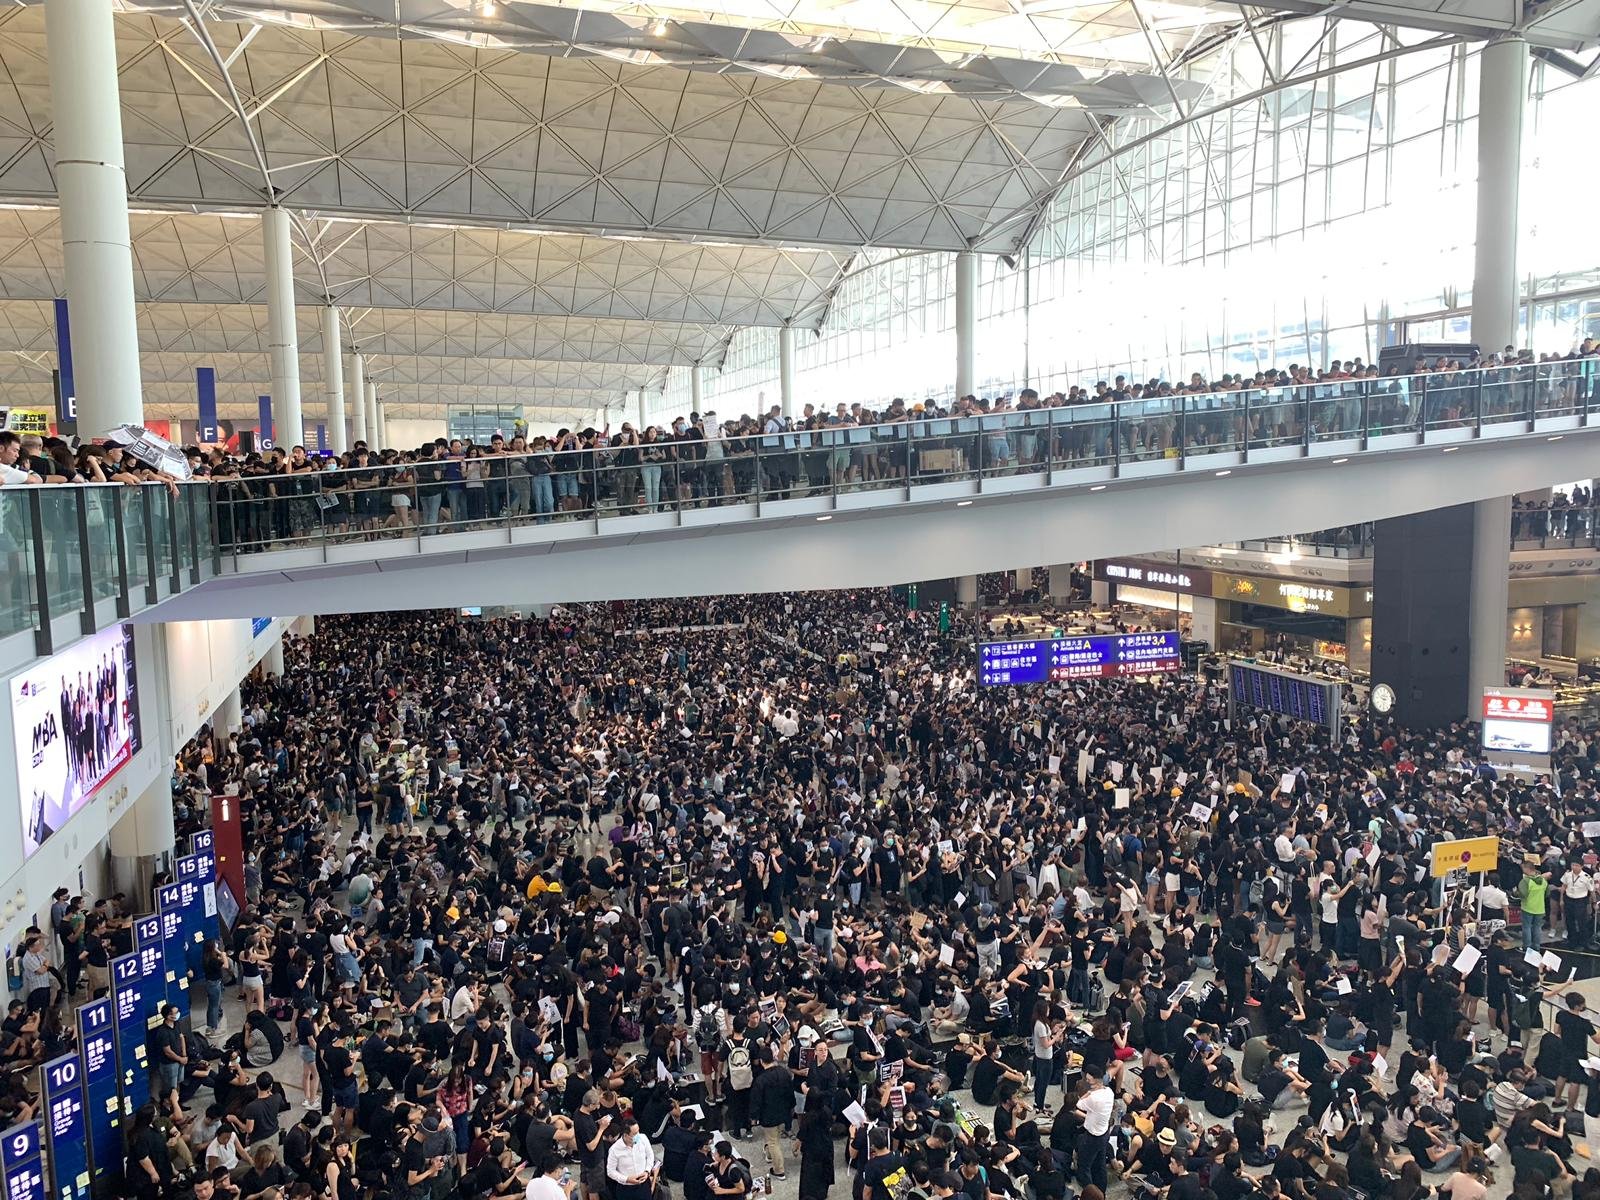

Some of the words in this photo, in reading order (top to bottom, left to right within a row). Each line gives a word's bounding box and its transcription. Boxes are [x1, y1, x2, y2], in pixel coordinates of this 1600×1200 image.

[204, 428, 214, 440] F
[262, 439, 272, 449] G
[1083, 640, 1091, 650] A
[1152, 635, 1166, 646] 3,4
[32, 711, 58, 753] MBA
[197, 834, 211, 848] 16
[180, 859, 195, 874] 15
[163, 888, 178, 904] 14
[140, 921, 158, 938] 13
[118, 960, 137, 978] 12
[88, 1006, 106, 1026] 11
[52, 1063, 75, 1086] 10
[13, 1134, 28, 1156] 9
